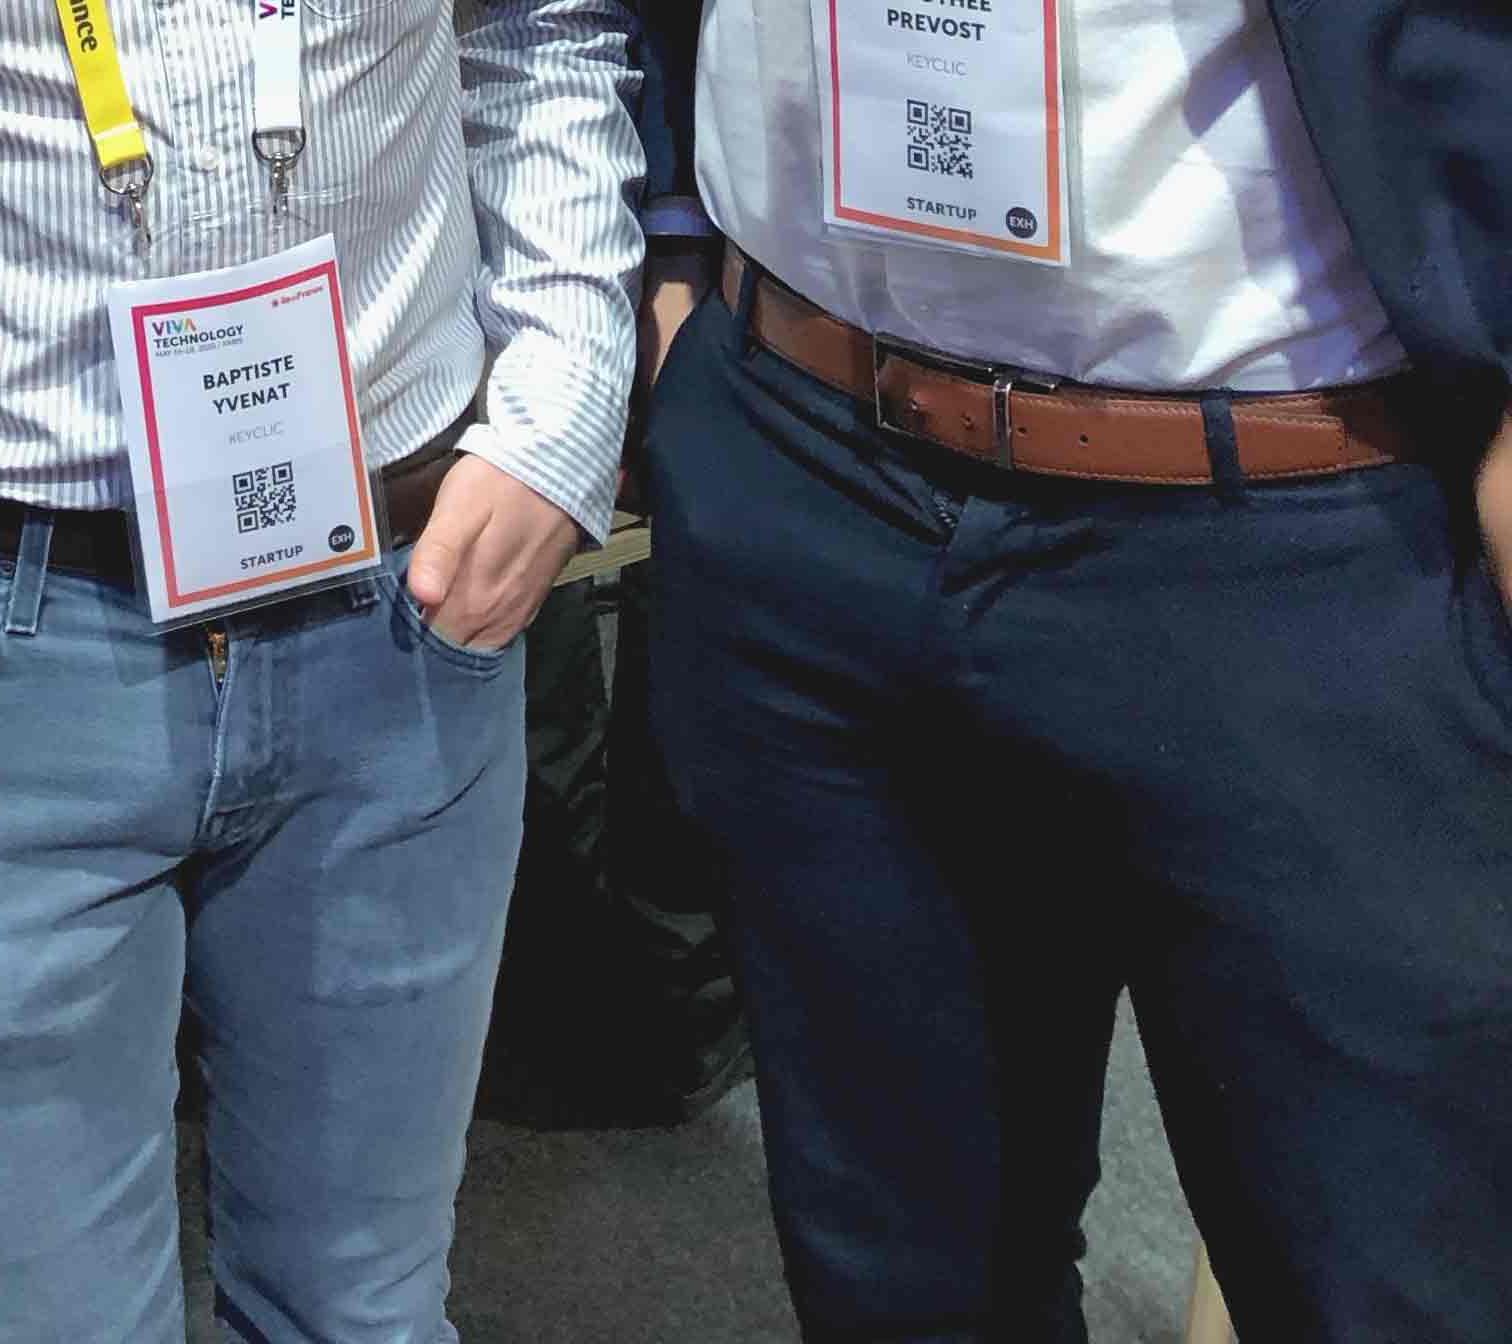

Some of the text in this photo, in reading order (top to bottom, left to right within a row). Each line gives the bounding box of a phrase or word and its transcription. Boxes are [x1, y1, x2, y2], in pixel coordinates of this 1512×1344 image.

[887, 9, 985, 41] PREVOST
[907, 198, 977, 221] STARTUP
[153, 318, 196, 336] VIVA
[154, 325, 243, 348] TECHNOLOGY
[203, 355, 295, 390] BAPTISTE
[213, 383, 290, 414] YVENAT
[241, 545, 303, 569] STARTUP
